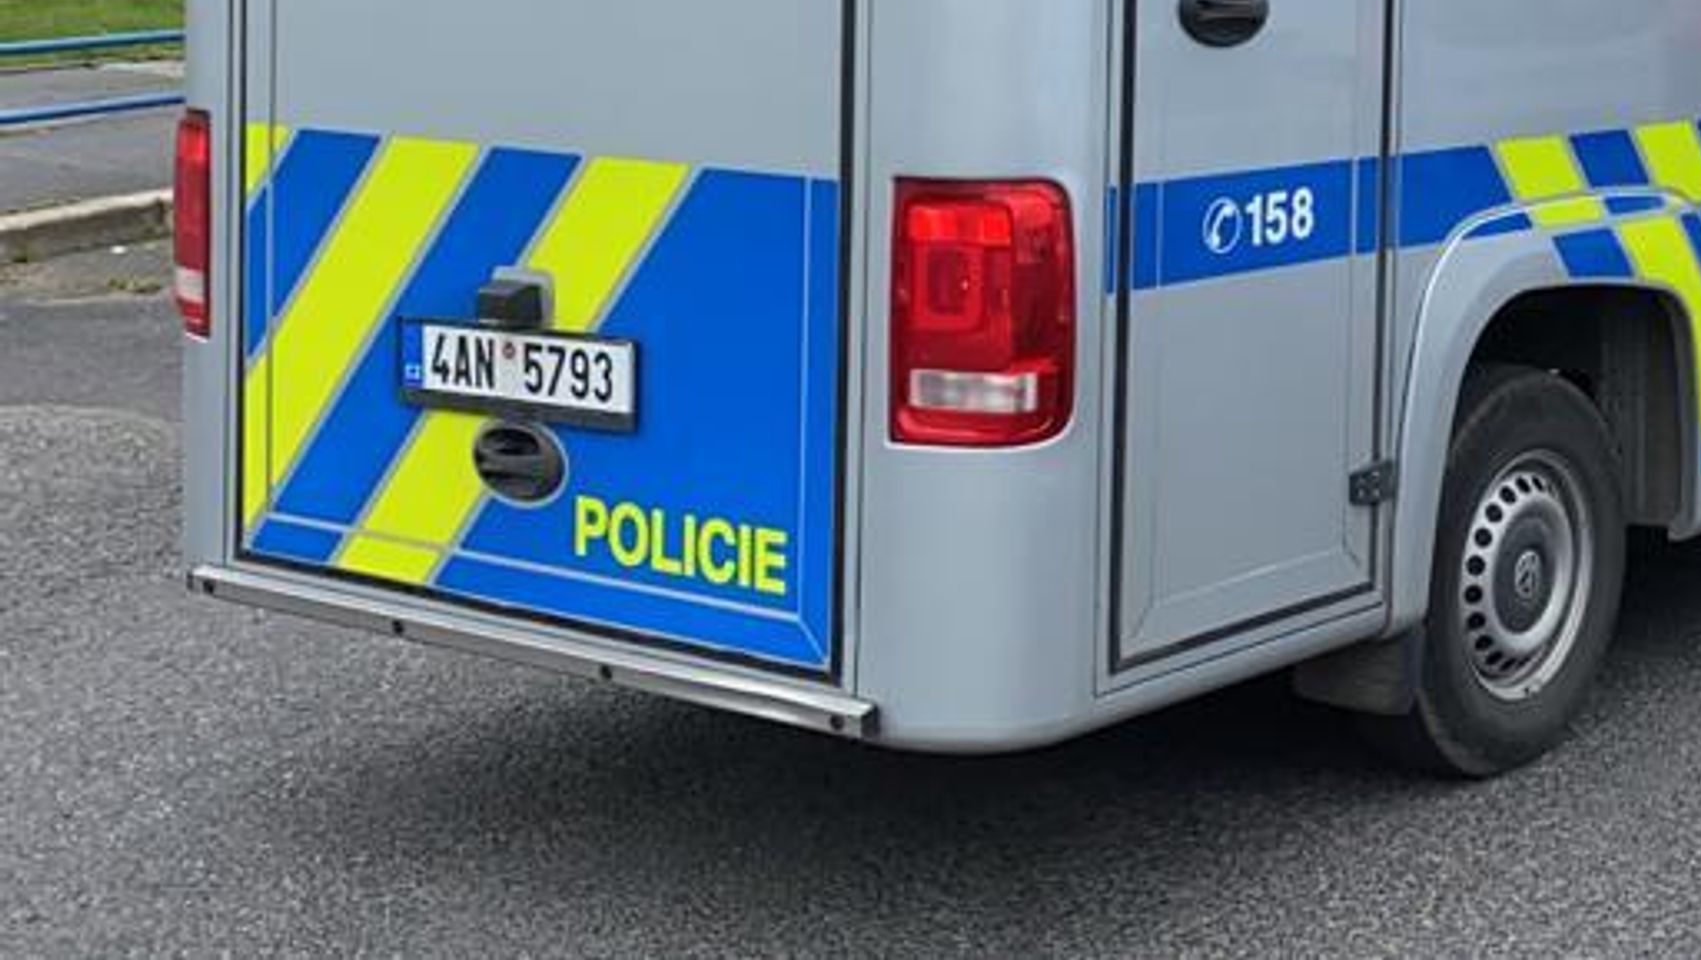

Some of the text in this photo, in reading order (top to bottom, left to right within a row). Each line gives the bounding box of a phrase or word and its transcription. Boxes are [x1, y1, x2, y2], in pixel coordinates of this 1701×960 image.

[1245, 186, 1314, 245] 158
[432, 332, 613, 403] 4AN 5793
[574, 494, 788, 597] POLICIE
